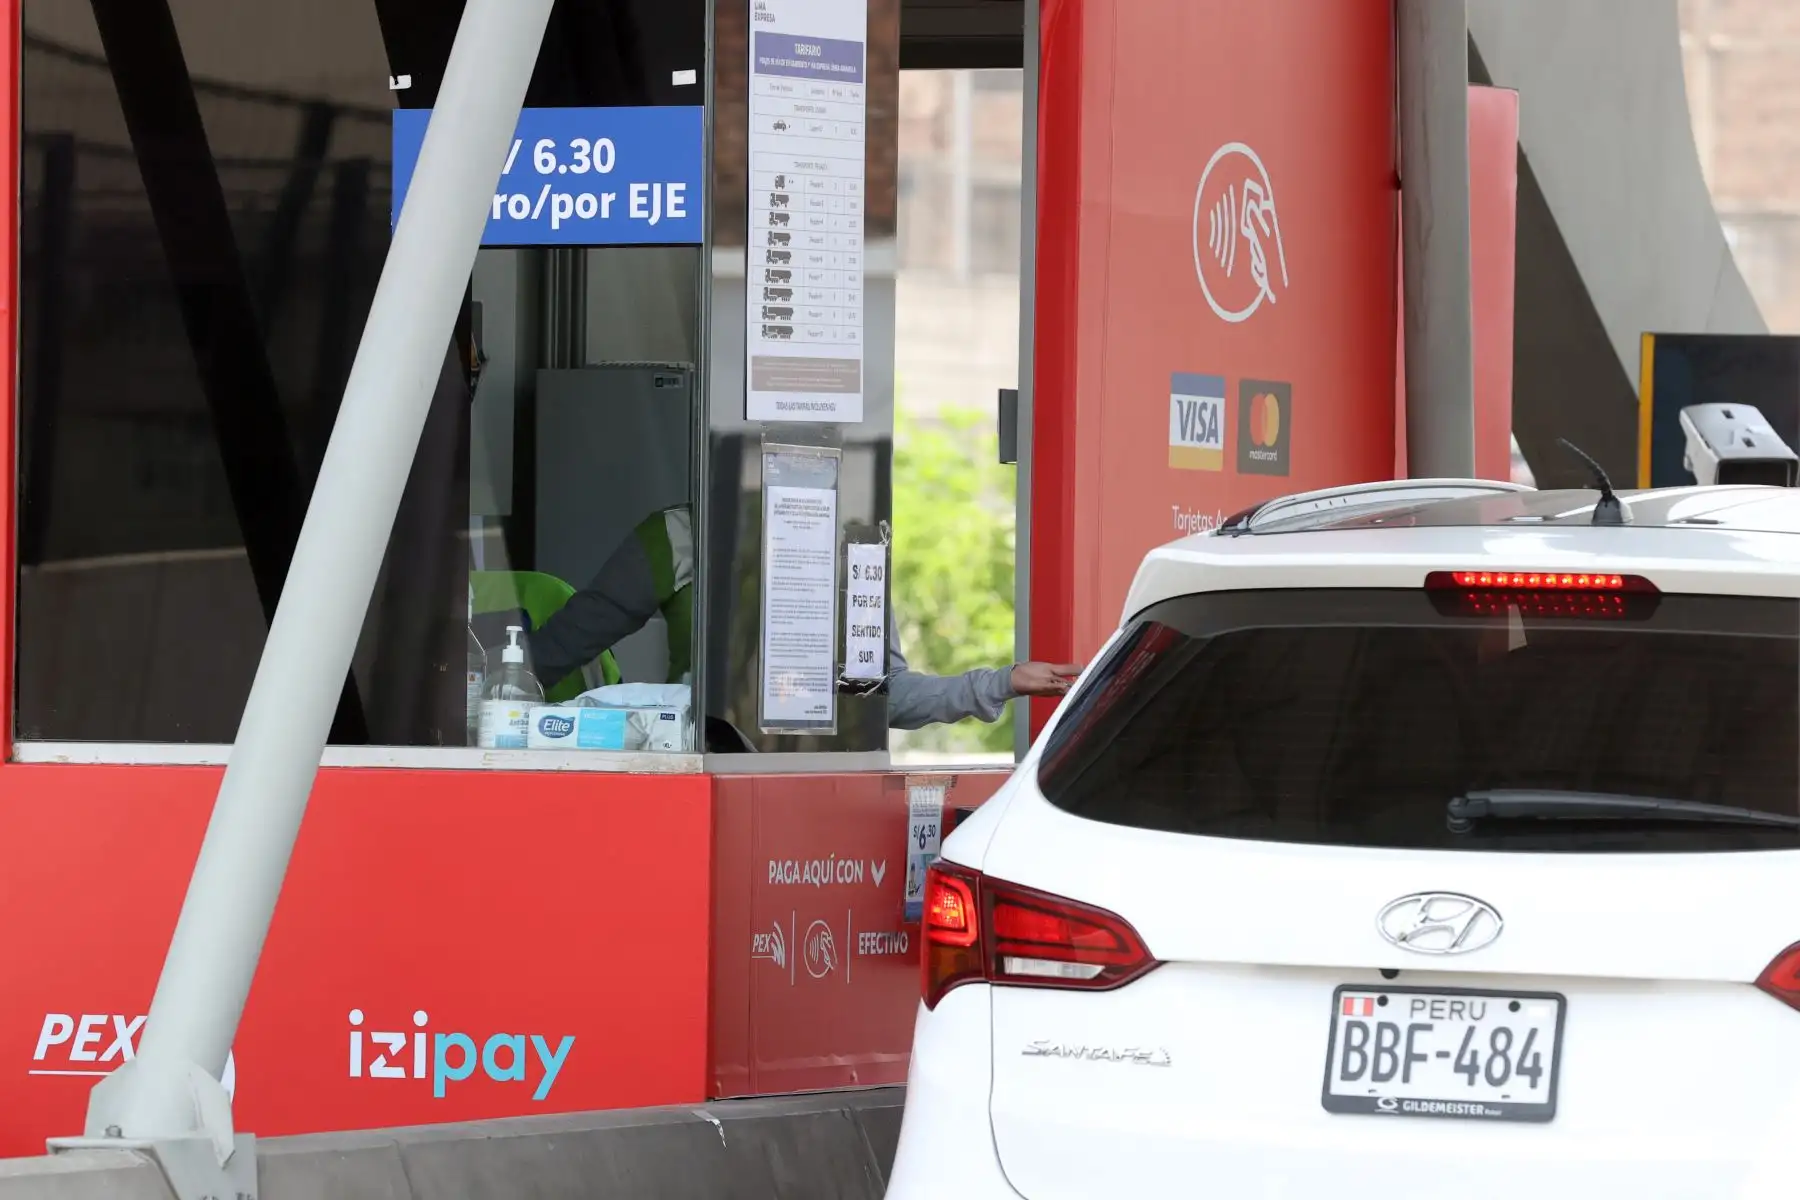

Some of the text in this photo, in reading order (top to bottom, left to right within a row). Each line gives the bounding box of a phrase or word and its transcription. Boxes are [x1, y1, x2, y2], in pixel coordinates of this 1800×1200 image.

[794, 43, 822, 57] TARIFARIO
[533, 137, 616, 175] 6.30
[492, 182, 687, 230] ro/por EJE
[1177, 399, 1219, 444] VISA
[1249, 449, 1278, 461] mastercard
[1172, 505, 1213, 536] Tarjetas
[865, 564, 883, 582] 6.30
[852, 594, 881, 608] POR EJE
[851, 624, 881, 638] SENTIDO
[858, 650, 875, 664] SUR
[543, 718, 569, 732] Elite
[768, 852, 863, 888] PAGA AQUÍ CON
[752, 933, 771, 953] PEX
[858, 932, 909, 955] EFECTIVO
[1409, 998, 1487, 1021] PERU
[33, 1013, 148, 1062] PEX
[348, 1008, 577, 1101] izipay
[1340, 1019, 1543, 1089] BBF-484
[1402, 1099, 1485, 1116] GILDEMEISTER
